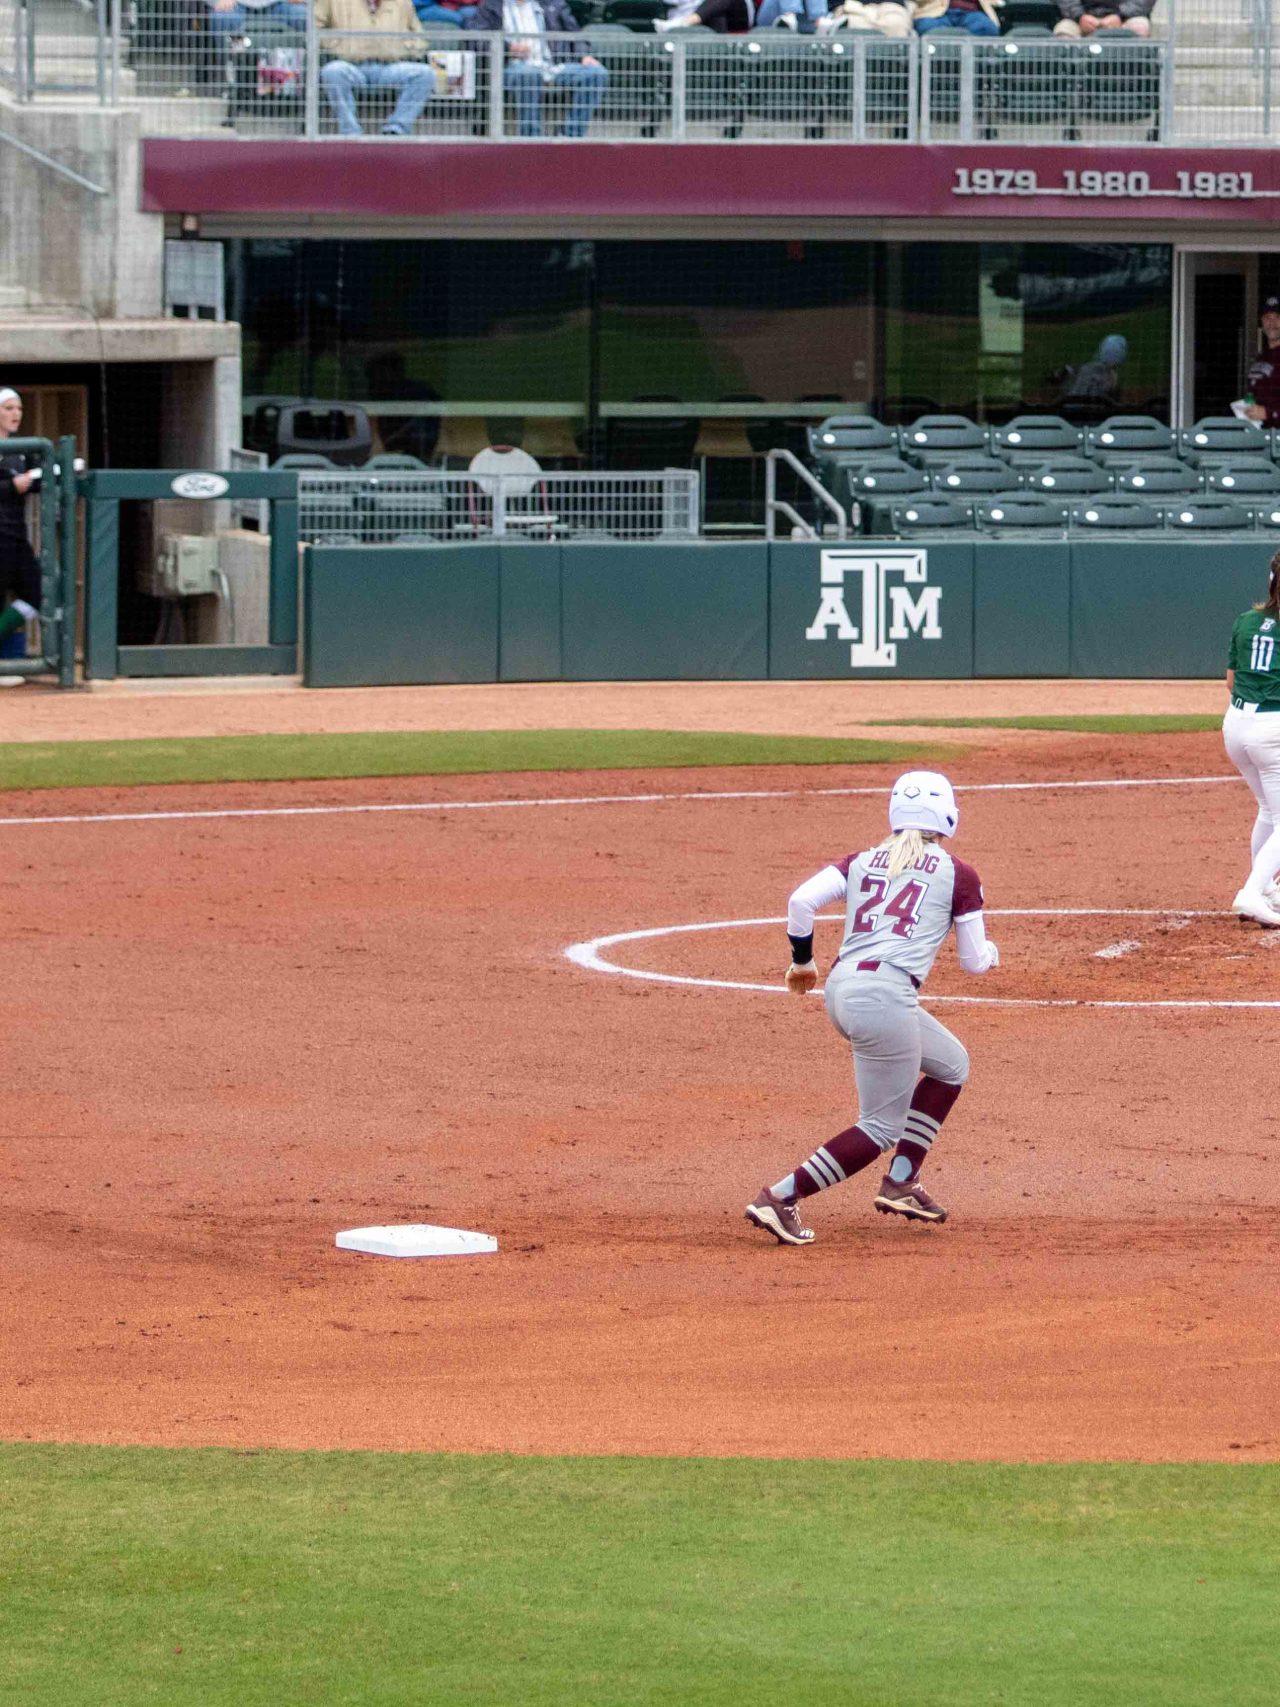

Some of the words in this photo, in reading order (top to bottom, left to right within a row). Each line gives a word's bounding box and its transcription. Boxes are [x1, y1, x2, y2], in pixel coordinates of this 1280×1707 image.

[953, 168, 1036, 195] 1979
[1063, 170, 1149, 196] 1980
[1176, 171, 1253, 197] 1981
[1250, 634, 1274, 671] 10
[852, 873, 929, 939] 24
